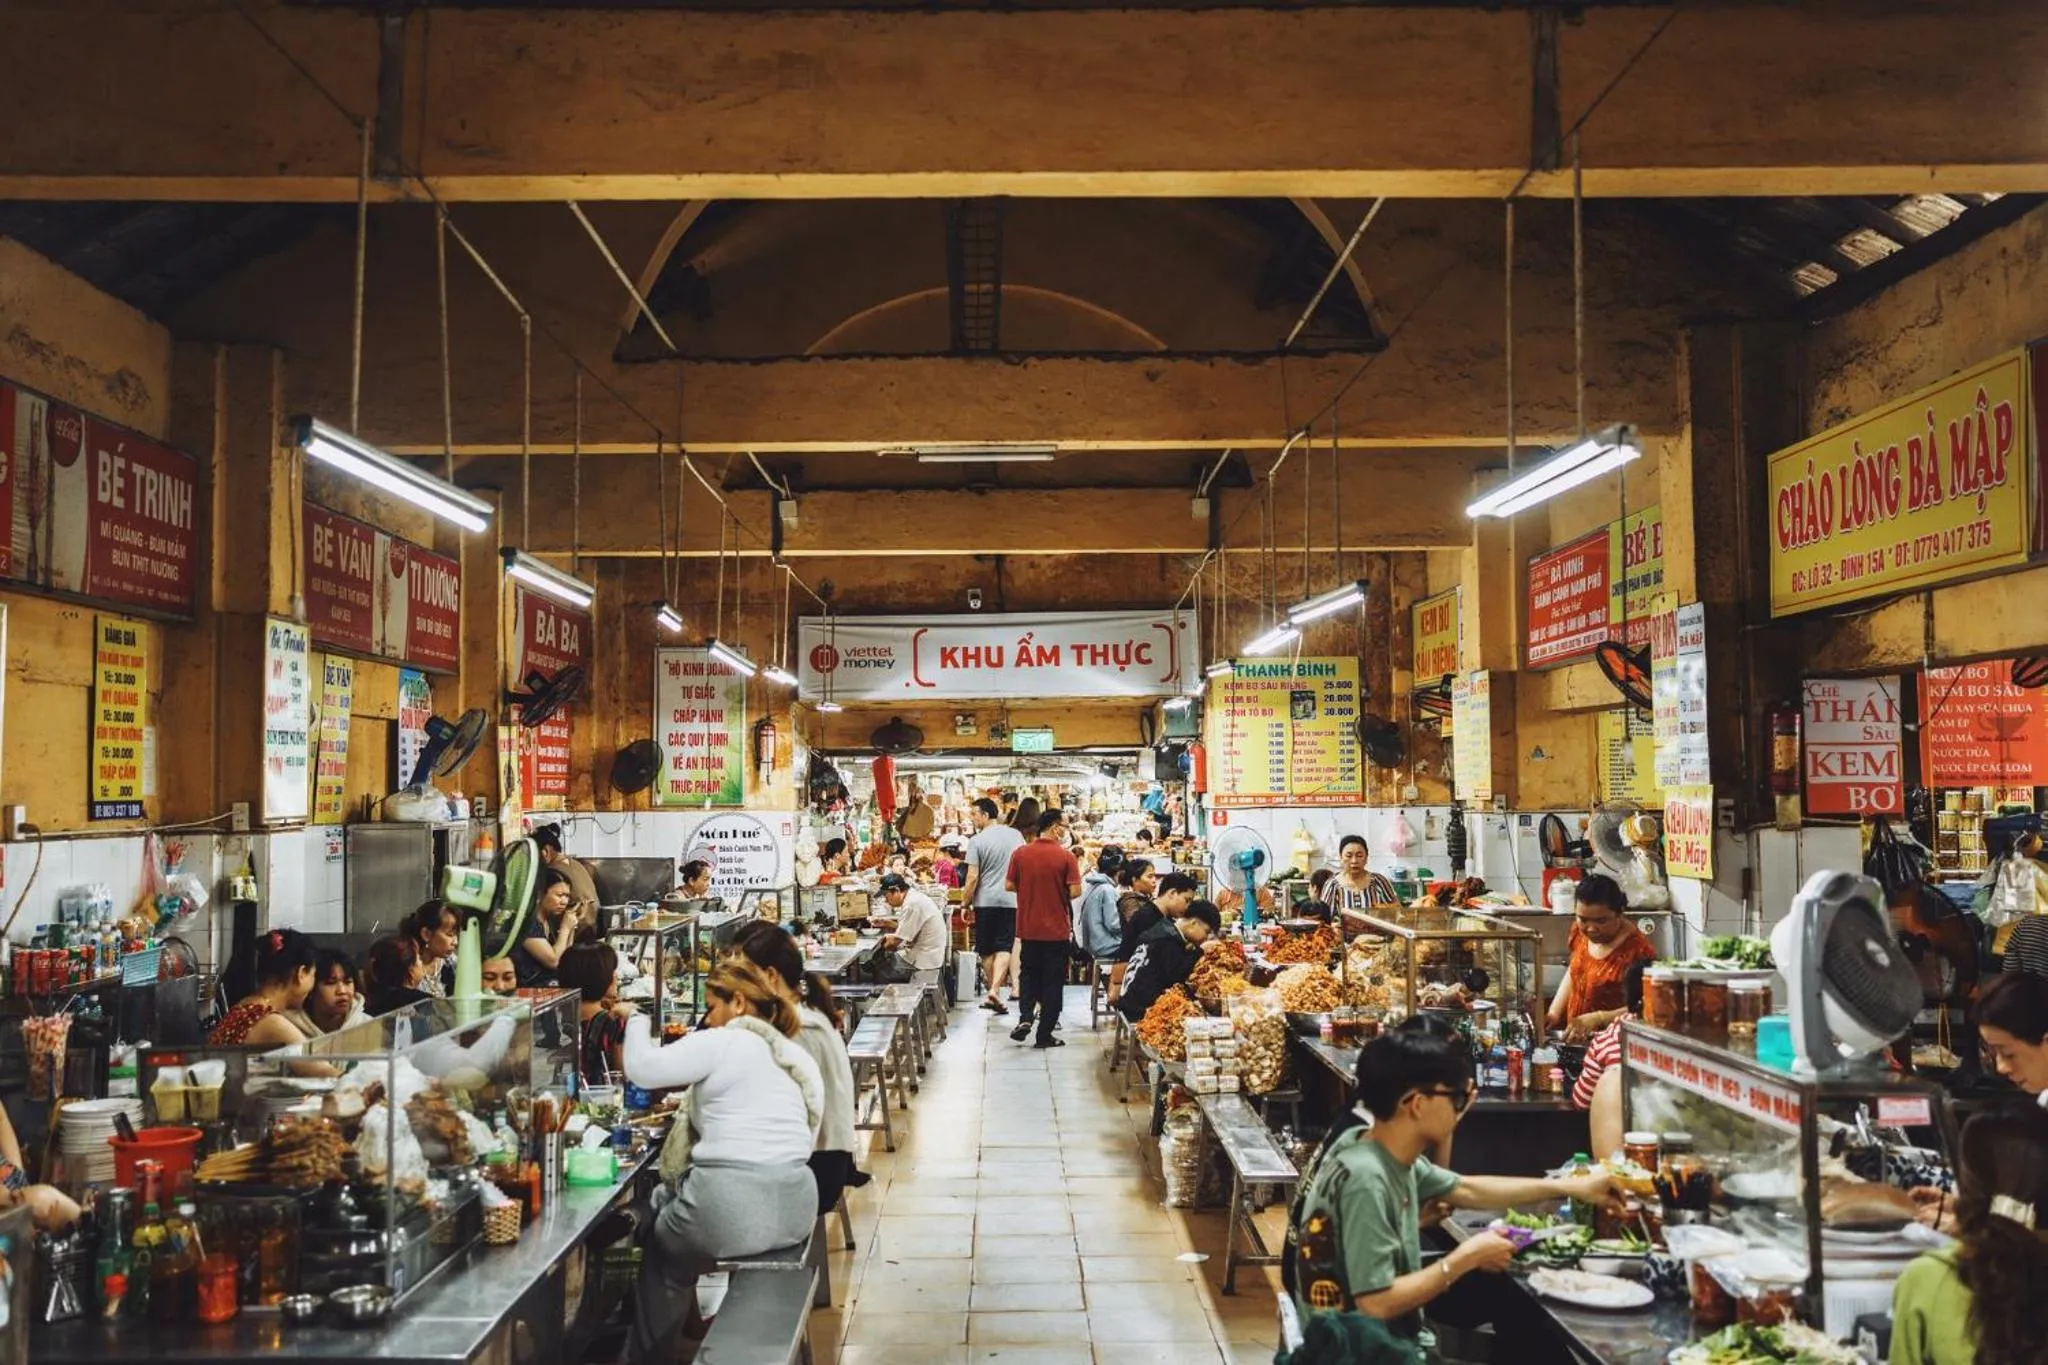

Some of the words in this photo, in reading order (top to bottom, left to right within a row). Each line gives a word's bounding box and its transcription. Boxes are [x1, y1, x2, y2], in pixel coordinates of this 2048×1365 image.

[1838, 439, 1901, 535] LÒNG
[1949, 385, 2013, 515] MẬP
[97, 443, 125, 509] BÉ
[131, 462, 192, 531] TRINH
[313, 517, 334, 568] BÉ
[338, 528, 372, 582] VÂN
[1821, 563, 1832, 585] 32
[1867, 549, 1885, 575] 15A
[1895, 543, 1911, 568] ĐT:
[1913, 535, 1940, 563] 0779
[1943, 527, 1964, 554] 417
[1968, 520, 1991, 549] 375
[1550, 560, 1561, 584] BÀ
[1562, 555, 1584, 579] VINH
[535, 605, 557, 649] BÀ
[560, 619, 579, 656] BA
[843, 647, 894, 658] viettel
[940, 646, 1003, 669] KHU
[1014, 632, 1061, 669] ẨM
[1071, 639, 1154, 672] THỰC
[683, 662, 704, 676] KINH
[843, 658, 895, 670] money
[1235, 664, 1291, 677] THANH
[1296, 660, 1336, 677] BÌNH
[694, 682, 716, 699] GIÁC
[1224, 682, 1245, 690] KEM
[1323, 680, 1353, 689] 25.000
[1930, 686, 1963, 697] KEM
[1224, 695, 1246, 704] KEM
[1323, 694, 1354, 703] 20.000
[1808, 691, 1897, 723] THÁI
[1323, 707, 1354, 716] 30.000
[688, 732, 704, 749] QUY
[1018, 736, 1050, 750] EXIT
[686, 756, 697, 769] AN
[1808, 750, 1896, 777] KEM
[1848, 785, 1896, 810] BƠ
[1684, 840, 1707, 872] Mập
